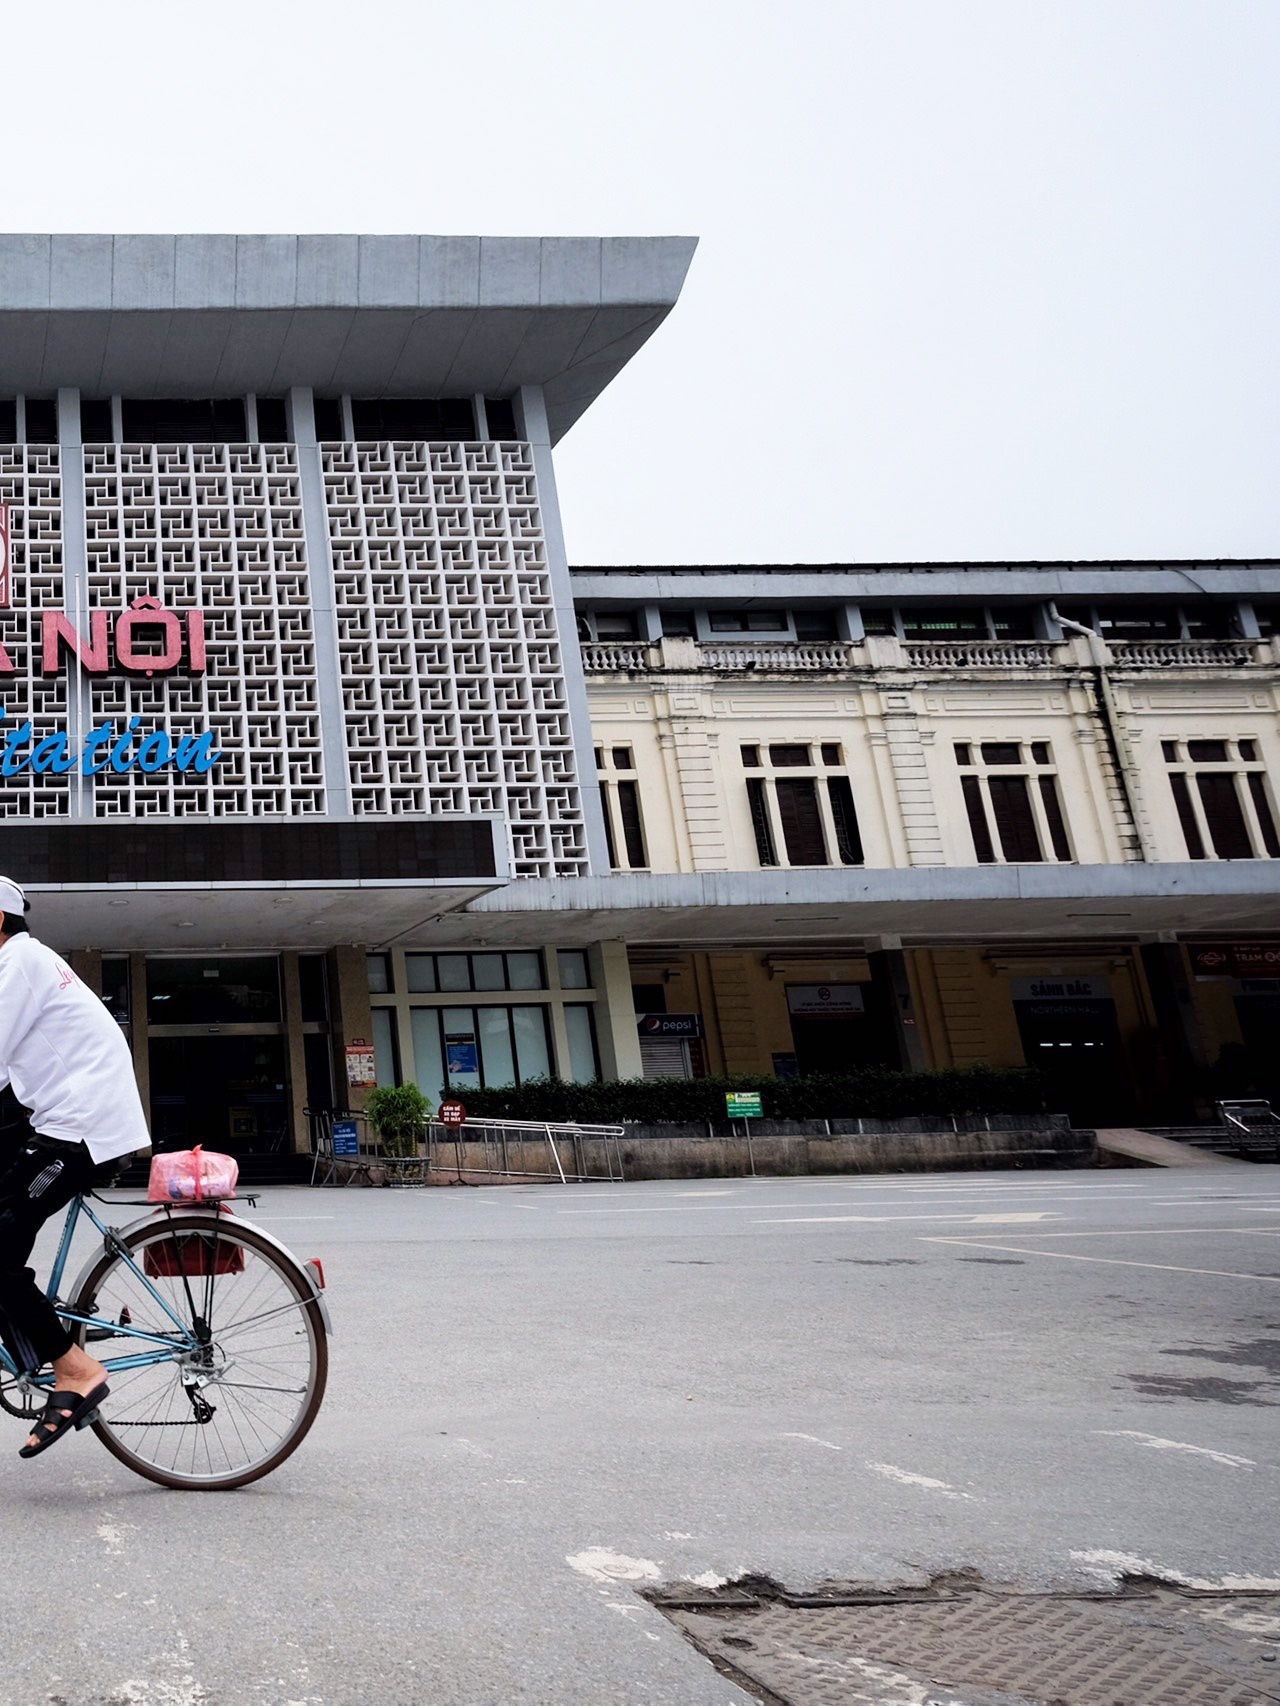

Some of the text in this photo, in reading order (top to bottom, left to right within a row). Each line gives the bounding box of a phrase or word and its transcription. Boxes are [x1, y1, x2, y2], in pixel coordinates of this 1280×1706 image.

[43, 595, 206, 679] NỘI
[1030, 980, 1064, 996] SẢNH
[898, 994, 909, 1009] 7
[662, 1020, 692, 1033] pepsi
